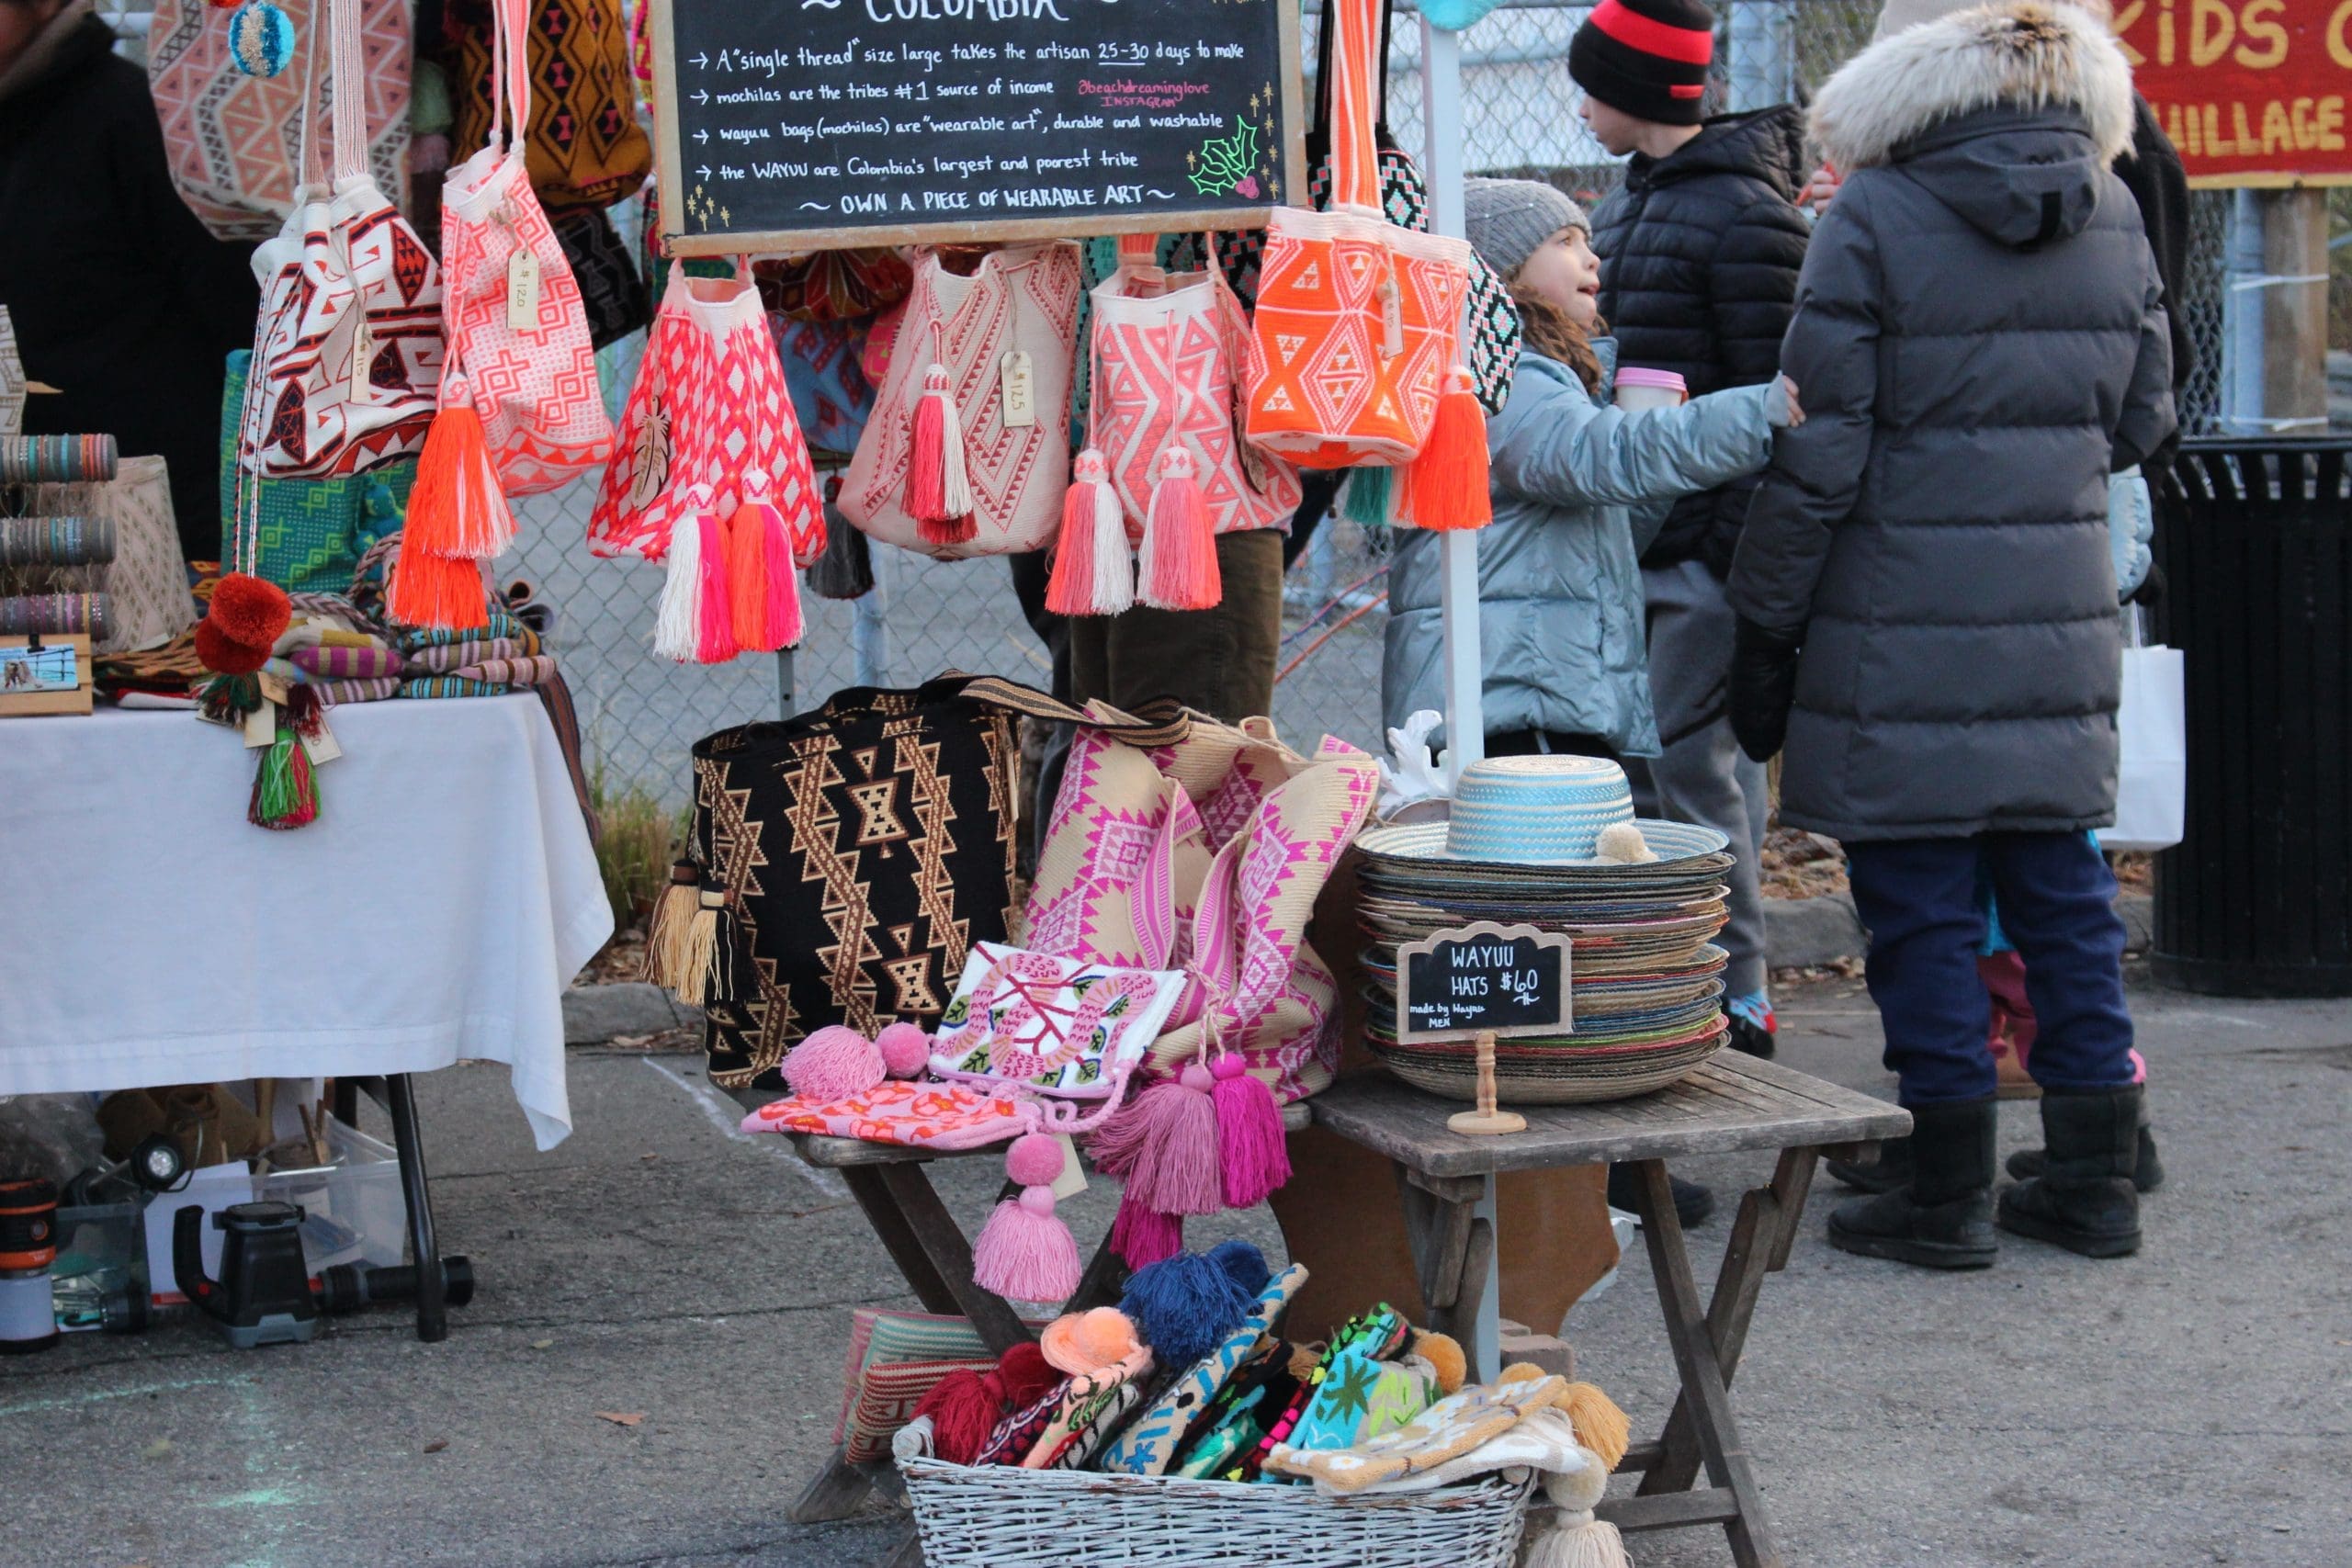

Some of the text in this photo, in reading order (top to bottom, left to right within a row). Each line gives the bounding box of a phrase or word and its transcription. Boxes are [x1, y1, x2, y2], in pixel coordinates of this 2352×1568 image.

[717, 48, 732, 72] A
[865, 47, 895, 63] size
[903, 43, 943, 73] large
[951, 43, 997, 60] takes
[1005, 42, 1026, 60] the
[1036, 41, 1090, 60] artisan
[1099, 42, 1148, 61] 25-30
[1156, 41, 1191, 66] days
[1196, 39, 1211, 59] to
[1215, 43, 1244, 59] make
[717, 87, 781, 105] mochilas
[789, 88, 813, 102] are
[819, 85, 841, 100] the
[847, 83, 888, 99] tribes
[936, 82, 978, 97] source
[988, 78, 1001, 96] of
[1009, 79, 1054, 95] income
[1101, 96, 1176, 108] INSTAGRAM
[720, 129, 770, 145] wayuu
[782, 121, 814, 143] bags
[817, 117, 888, 139] (mochilas)
[896, 120, 921, 133] are
[1053, 114, 1103, 130] durable
[1113, 115, 1140, 130] and
[1149, 112, 1224, 129] washable
[719, 149, 1138, 180] the WAYUU are Colombia's largest and poorest tribe
[840, 185, 1143, 214] OWN A PIECE OF WEARABLE ART
[1451, 945, 1514, 968] WAYUU
[1451, 969, 1538, 996] HATS $60
[1409, 1002, 1435, 1014] made
[1437, 1002, 1449, 1017] by
[1429, 1017, 1451, 1028] MEN
